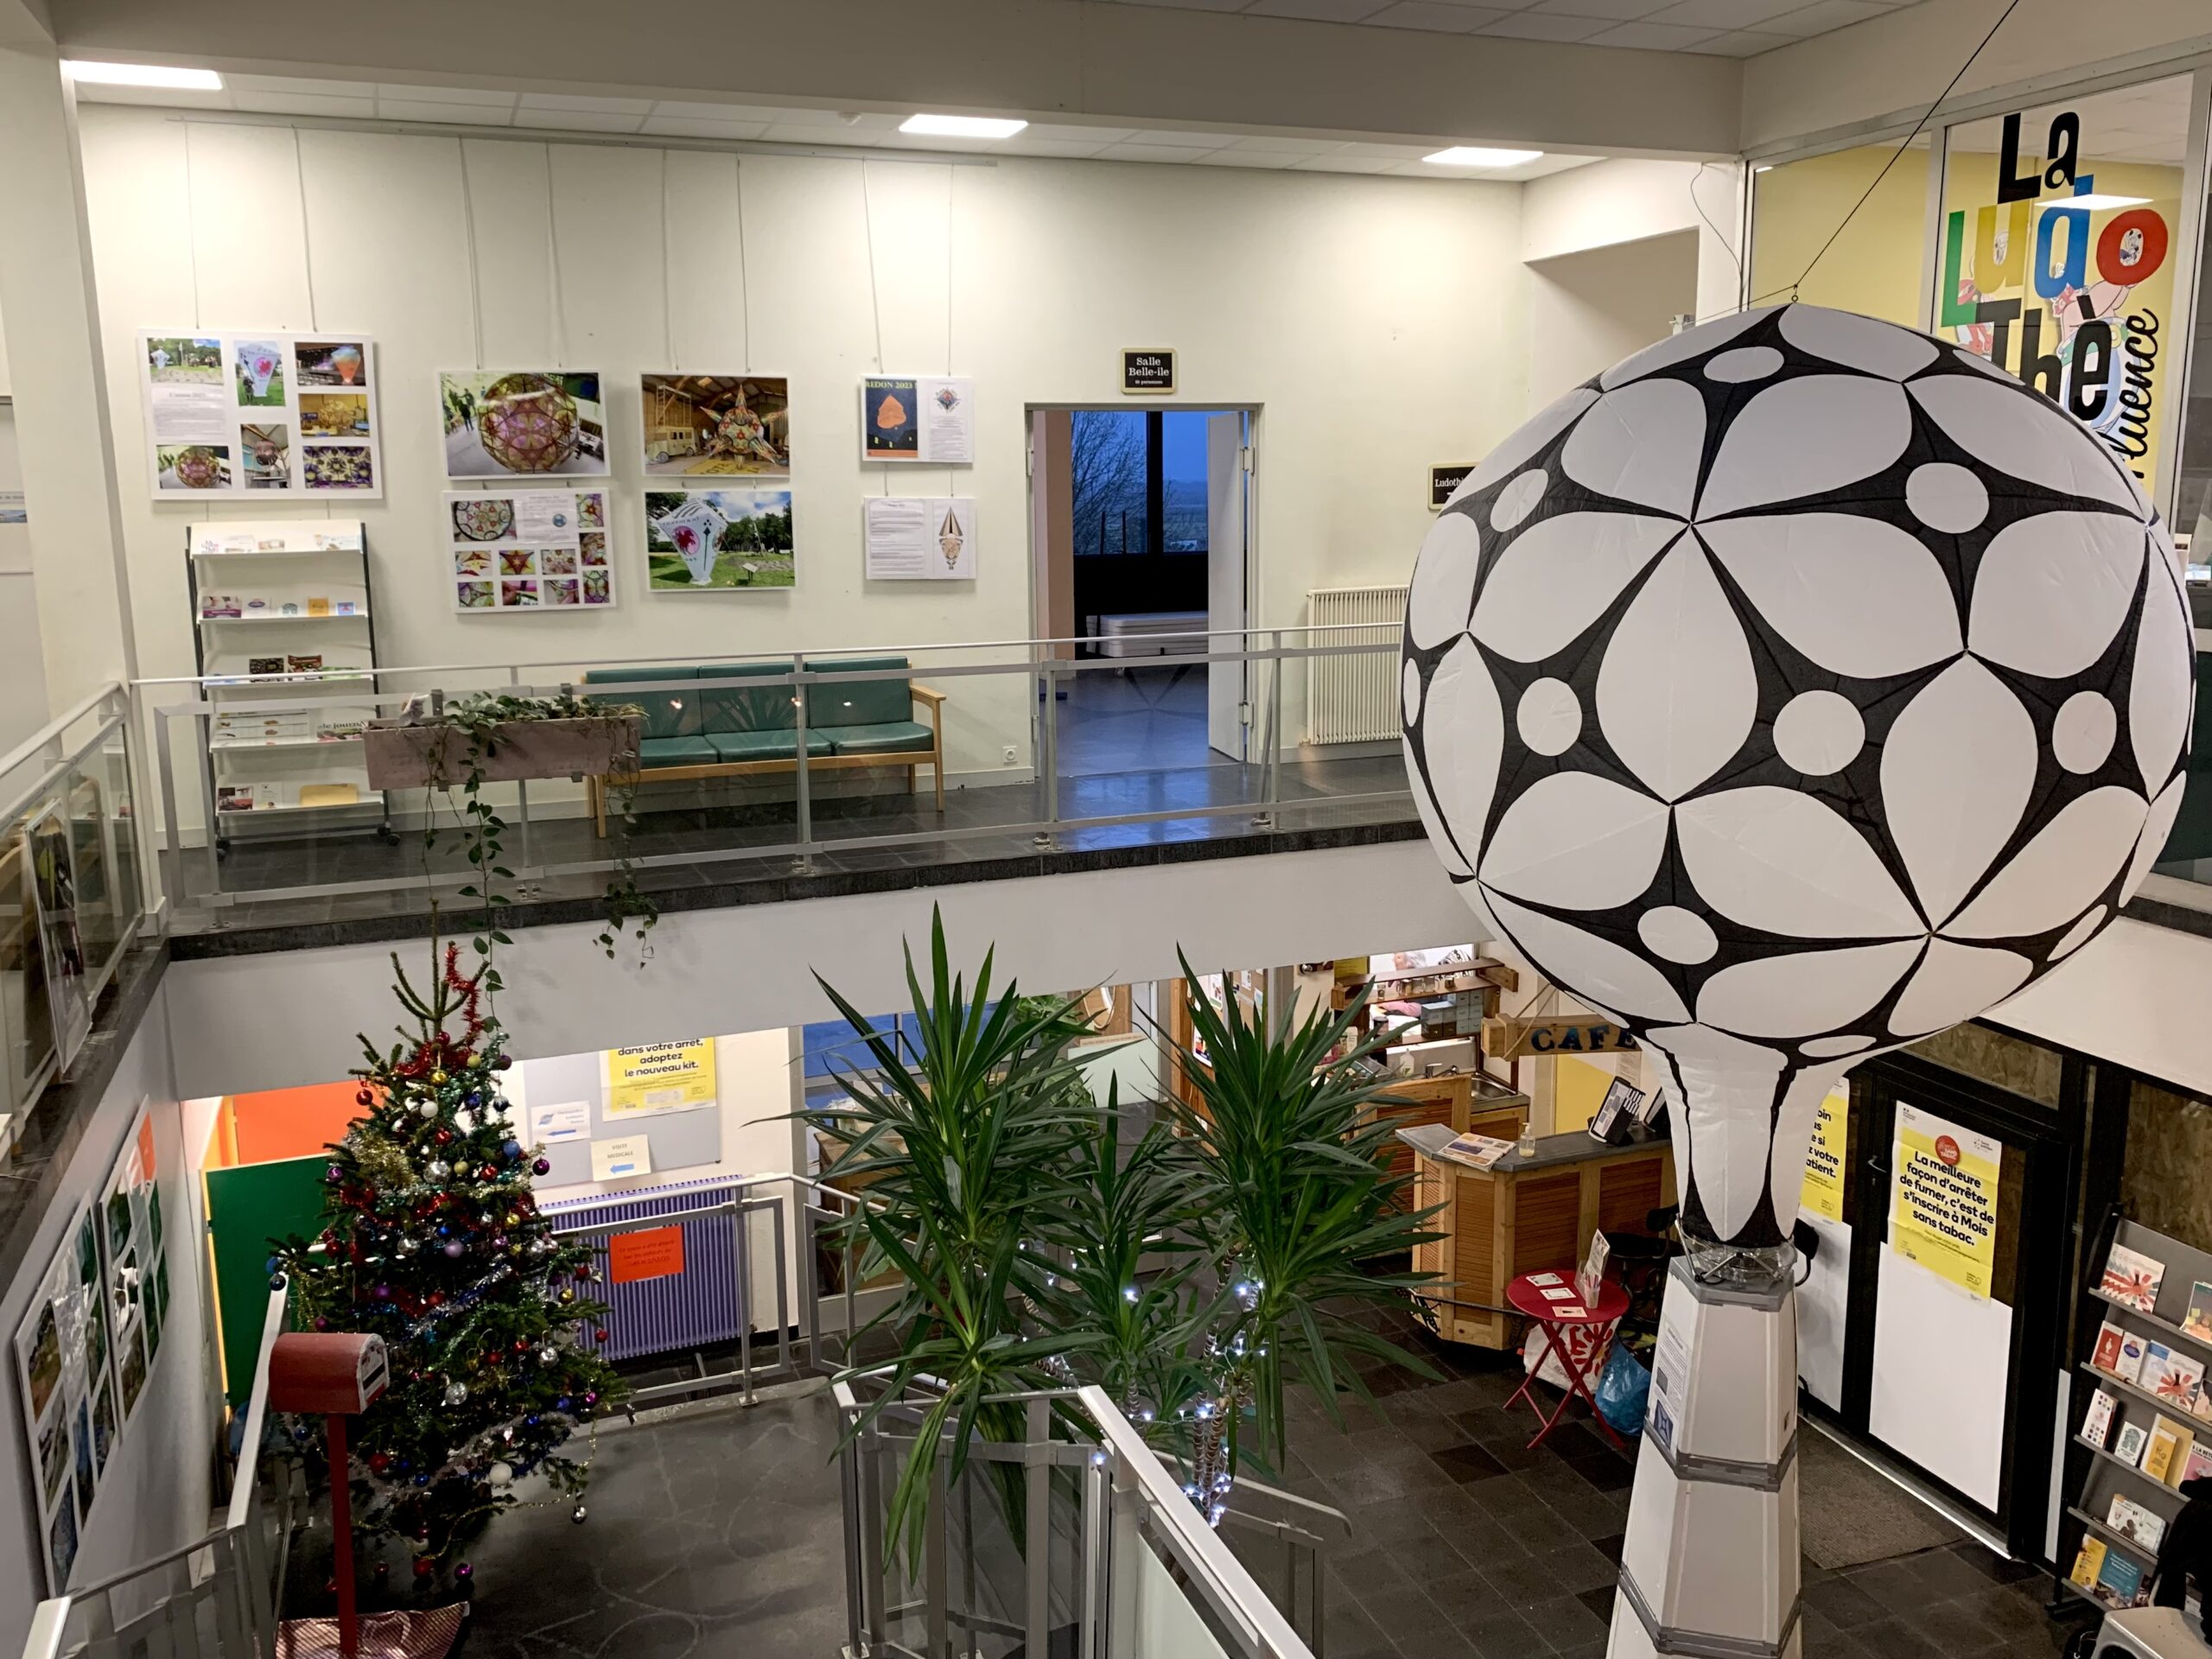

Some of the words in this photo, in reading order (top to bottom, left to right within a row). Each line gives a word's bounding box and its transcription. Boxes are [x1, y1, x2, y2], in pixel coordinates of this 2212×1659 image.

[1998, 111, 2080, 205] La
[1941, 174, 2169, 327] Ludo
[1136, 356, 1161, 366] Salle
[895, 381, 913, 390] 2023
[1434, 477, 1464, 487] Ludoth
[618, 1046, 644, 1056] dans
[646, 1042, 674, 1052] votre
[639, 1052, 683, 1064] adoptez
[625, 1068, 634, 1077] le
[636, 1064, 681, 1076] nouveau
[683, 1061, 698, 1071] kit.
[1817, 1136, 1826, 1147] si
[1814, 1148, 1840, 1166] votre
[1906, 1162, 1938, 1185] façon
[1915, 1151, 1929, 1166] La
[1929, 1160, 1981, 1189] meilleure
[1899, 1174, 1913, 1187] de
[1915, 1180, 1948, 1205] fumer,
[1980, 1211, 1994, 1224] de
[1913, 1210, 1938, 1229] sans
[1939, 1221, 1975, 1246] tabac.
[1951, 1211, 1959, 1224] à
[1961, 1217, 1988, 1236] Mois
